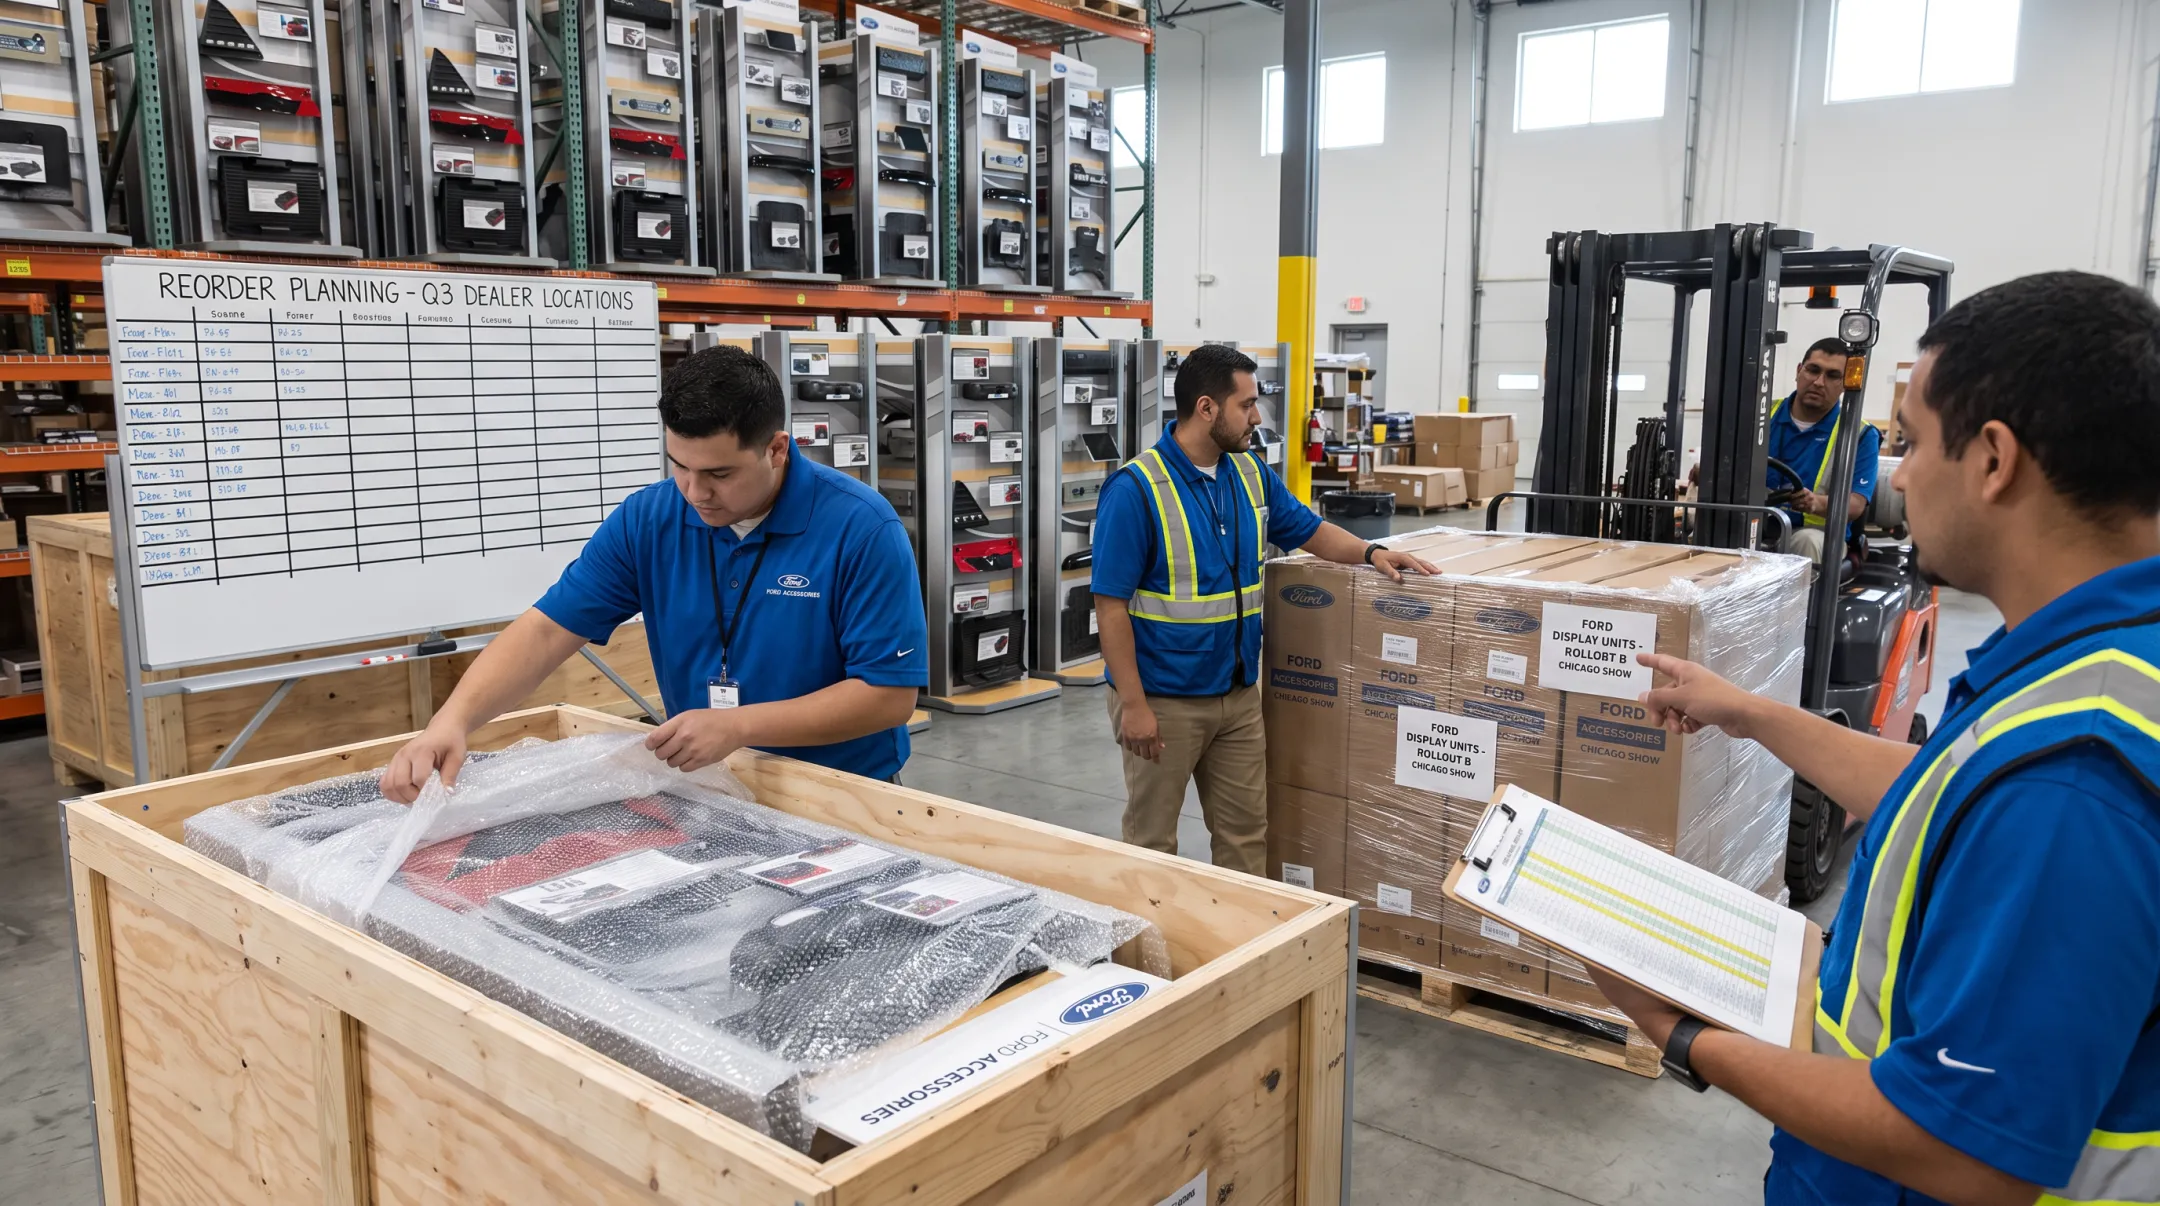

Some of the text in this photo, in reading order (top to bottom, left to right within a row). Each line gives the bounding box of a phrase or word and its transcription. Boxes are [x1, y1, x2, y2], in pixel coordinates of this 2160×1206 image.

[159, 272, 276, 301] REORDER
[290, 277, 400, 303] PLANNING
[422, 282, 454, 305] Q3
[465, 284, 534, 307] DEALER
[543, 288, 634, 311] LOCATIONS
[783, 590, 820, 598] ACCESSORIES
[1582, 619, 1613, 632] FORD
[1552, 631, 1599, 645] DISPLAY
[1602, 636, 1636, 650] UNITS
[1287, 655, 1322, 670] FORD
[1619, 654, 1627, 664] B
[1380, 669, 1418, 685] FORD
[1558, 661, 1632, 678] CHICAGO SHOW
[1274, 674, 1335, 691] ACCESSORIES
[1483, 685, 1525, 702] FORD
[1310, 696, 1335, 709] SHOW
[1600, 702, 1646, 720] FORD
[1431, 723, 1459, 735] FORD
[1581, 723, 1662, 745] ACCESSORIES
[1406, 733, 1448, 747] DISPLAY
[1449, 741, 1479, 754] UNITS
[1417, 748, 1472, 766] ROLLOUT B
[1580, 744, 1661, 765] CHICAGO SHOW
[1412, 761, 1476, 780] CHICAGO SHOW
[1075, 987, 1134, 1019] Ford
[860, 1030, 1049, 1125] FORD ACCESSORIES
